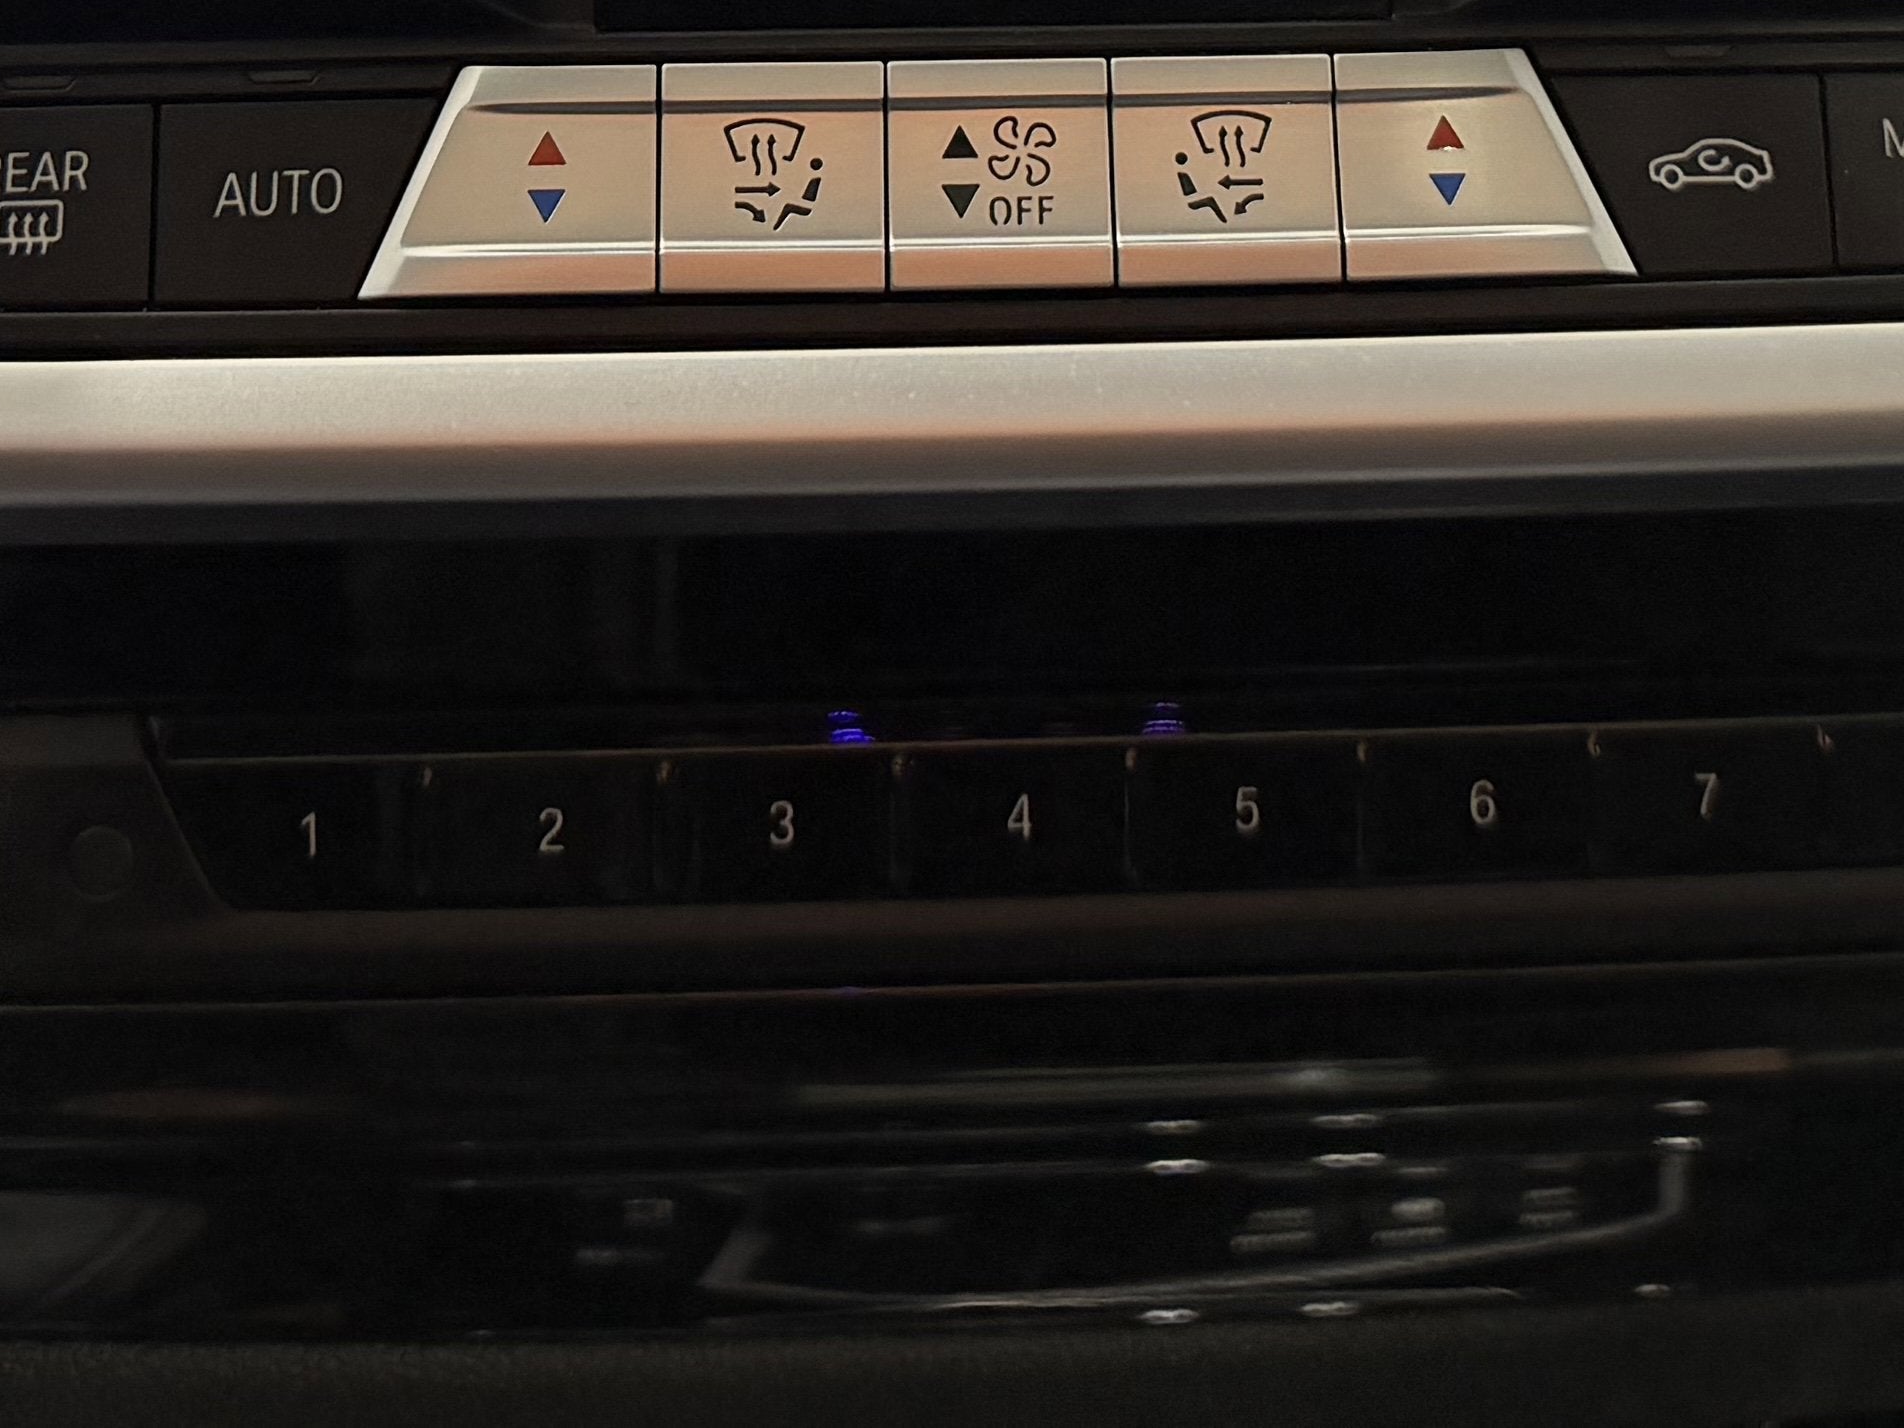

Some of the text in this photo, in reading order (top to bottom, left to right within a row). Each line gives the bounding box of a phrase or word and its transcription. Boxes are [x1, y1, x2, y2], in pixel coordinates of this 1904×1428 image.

[214, 168, 343, 217] AUTO
[989, 195, 1054, 228] OFF
[1007, 793, 1032, 838] 4
[1235, 786, 1260, 832] 5
[1469, 779, 1495, 825] 6
[1695, 771, 1718, 817] 7
[301, 812, 318, 857] 1
[539, 807, 564, 853] 2
[769, 800, 794, 845] 3
